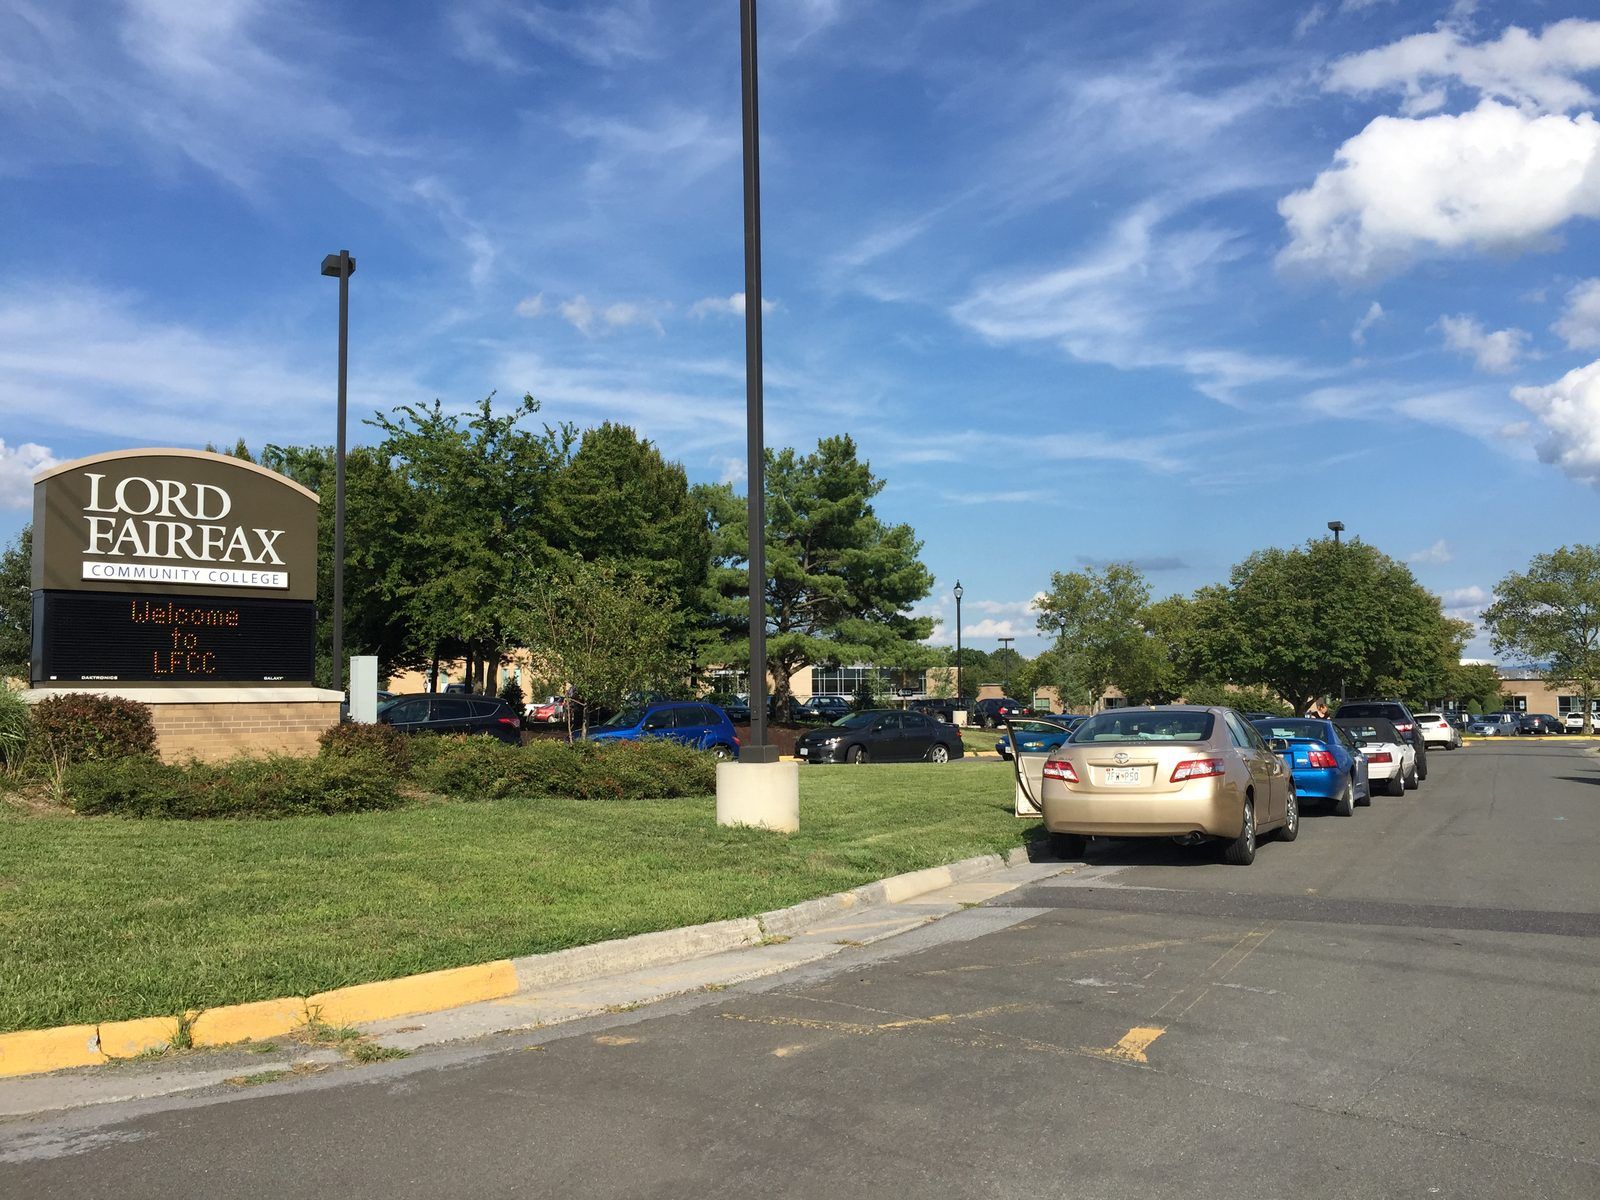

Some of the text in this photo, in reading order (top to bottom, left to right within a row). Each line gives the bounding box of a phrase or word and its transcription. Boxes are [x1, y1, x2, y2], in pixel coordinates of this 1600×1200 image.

[83, 473, 231, 520] LORD
[82, 515, 285, 564] FAIRFAX
[91, 564, 280, 585] COMMUNITY COLLEGE
[130, 601, 239, 626] Welcome
[171, 627, 197, 649] to
[153, 651, 216, 673] LFCC
